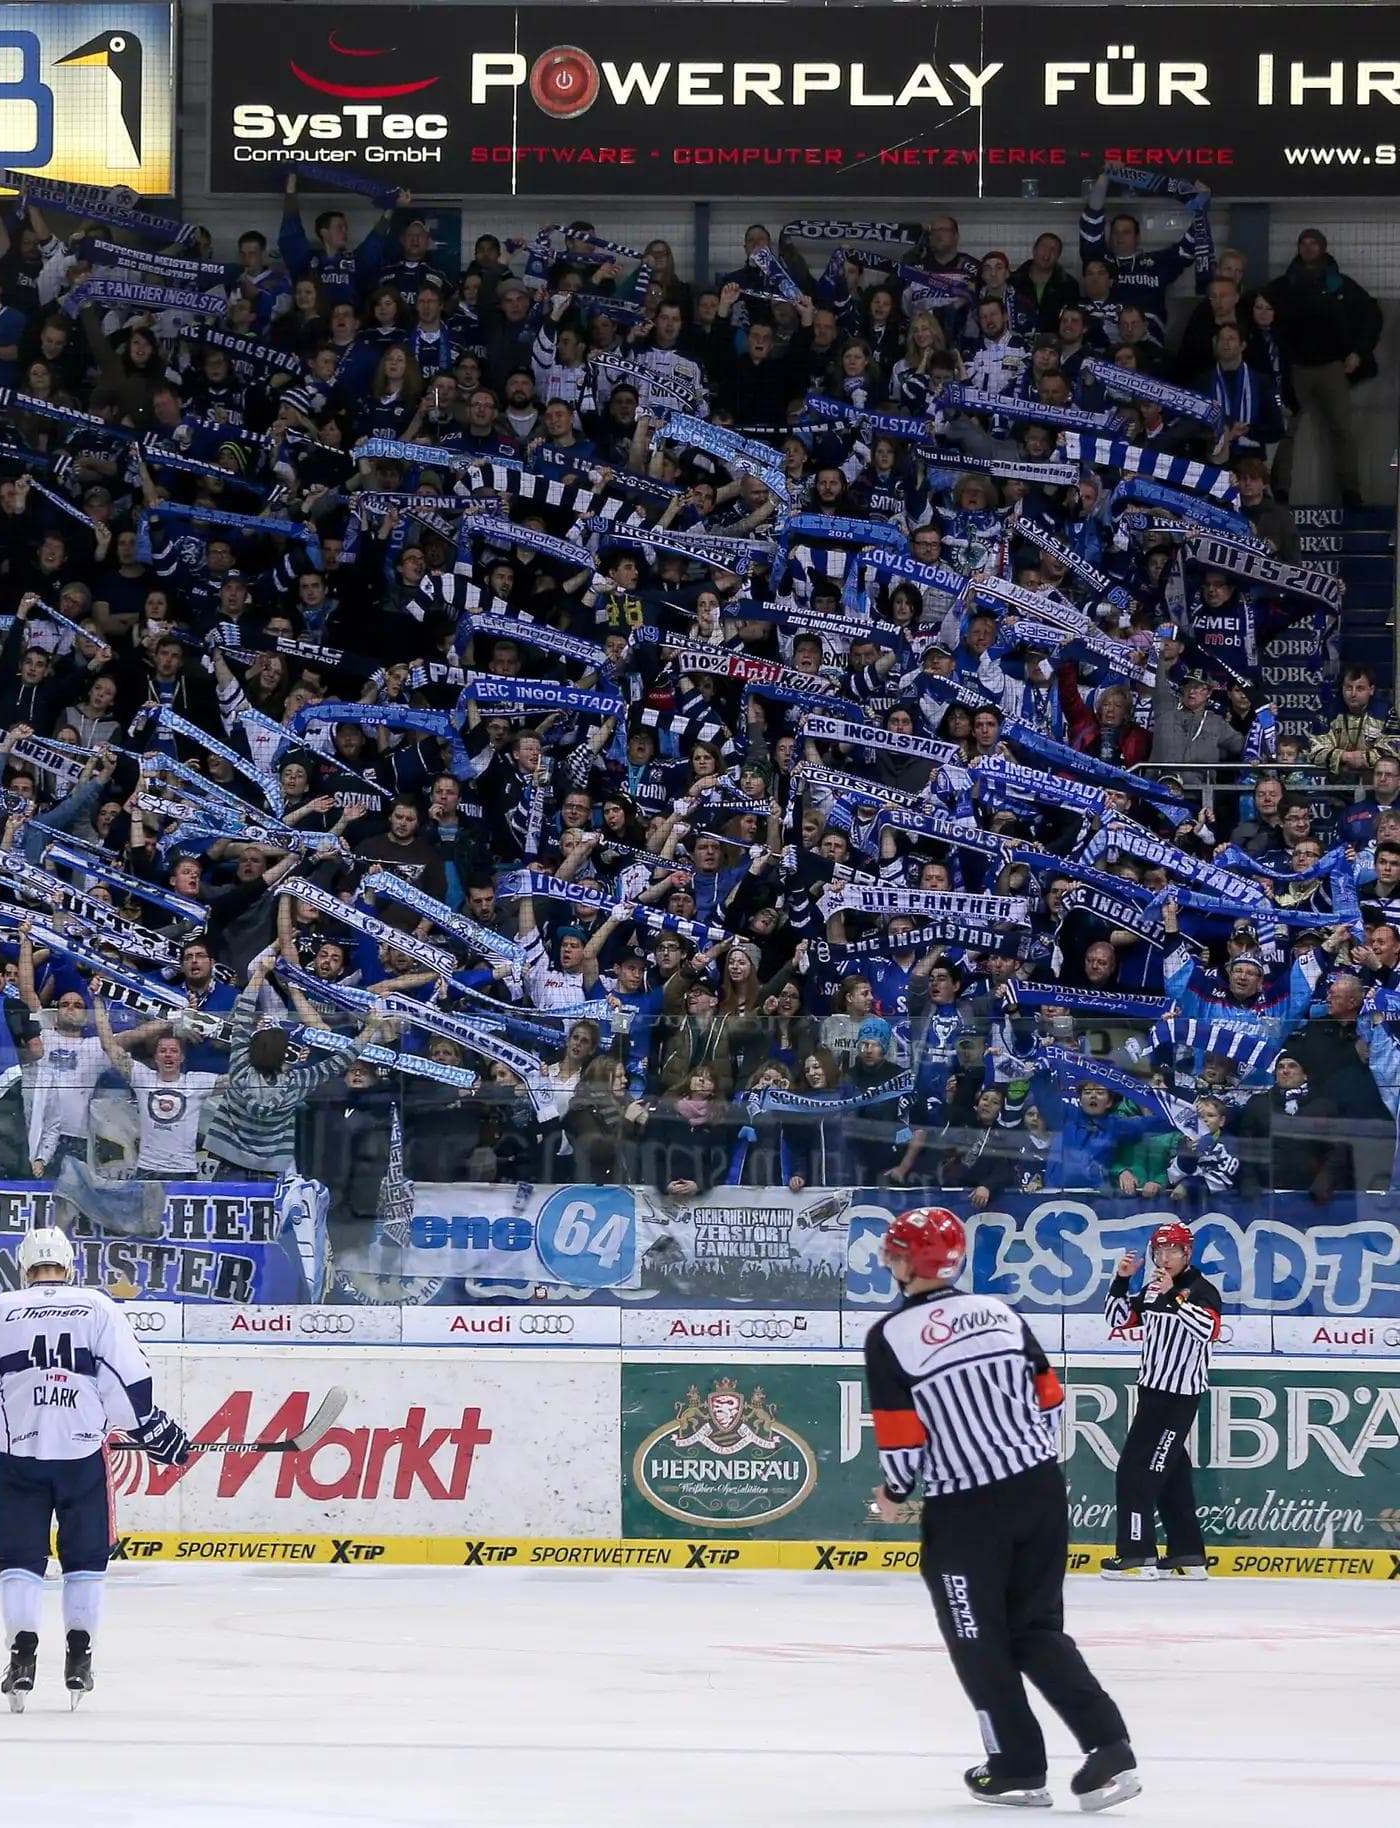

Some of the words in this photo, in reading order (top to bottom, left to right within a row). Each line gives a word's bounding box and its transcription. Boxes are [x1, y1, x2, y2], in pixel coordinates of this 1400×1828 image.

[1045, 45, 1212, 106] FÜR
[233, 104, 448, 145] SysTec
[234, 146, 357, 163] Computer
[365, 145, 441, 162] GmbH
[471, 147, 636, 164] SOFTWARE
[673, 148, 844, 165] COMPUTER
[880, 149, 1066, 165] NETZWERKE
[1104, 149, 1234, 165] SERVICE
[67, 195, 177, 230] INGOLSTADT
[158, 252, 200, 270] MEISTER
[200, 263, 225, 274] 2014
[107, 283, 161, 302] PANTHER
[828, 530, 854, 539] 2014
[876, 621, 901, 635] 2014
[681, 652, 728, 673] 110%
[731, 655, 779, 682] Anti
[475, 680, 509, 697] ERC
[514, 686, 624, 715] INGOLSTADT
[807, 719, 837, 734] ERC
[843, 724, 952, 761] INGOLSTADT
[1005, 761, 1105, 802] INGOLSTADT
[333, 791, 381, 813] SATURN
[891, 812, 924, 827] ERC
[1108, 828, 1265, 902] INGOLSTADT
[862, 892, 901, 907] DIE
[909, 894, 1011, 916] PANTHER
[1251, 913, 1280, 923] 2014
[888, 925, 1005, 949] INGOLSTADT
[424, 1013, 540, 1073] INGOLSTADT
[1217, 1143, 1241, 1176] 38
[694, 1208, 793, 1226] SICHERHEITSWAHN
[553, 1201, 631, 1269] 64
[696, 1222, 793, 1243] ZERSTÖRT
[696, 1241, 790, 1259] FANKULTUR
[231, 1314, 291, 1332] Audi
[450, 1316, 510, 1333] Audi
[669, 1320, 730, 1337] Audi
[1313, 1326, 1375, 1344] Audi
[33, 1386, 78, 1409] CLARK
[145, 1390, 492, 1501] Markt
[1155, 1430, 1176, 1473] Dorint
[651, 1459, 800, 1481] HERRNBRÄU
[176, 1542, 316, 1559] SPORTWETTEN
[530, 1546, 671, 1565] SPORTWETTEN
[1232, 1556, 1374, 1574] SPORTWETTEN
[951, 1574, 979, 1640] Dorint
